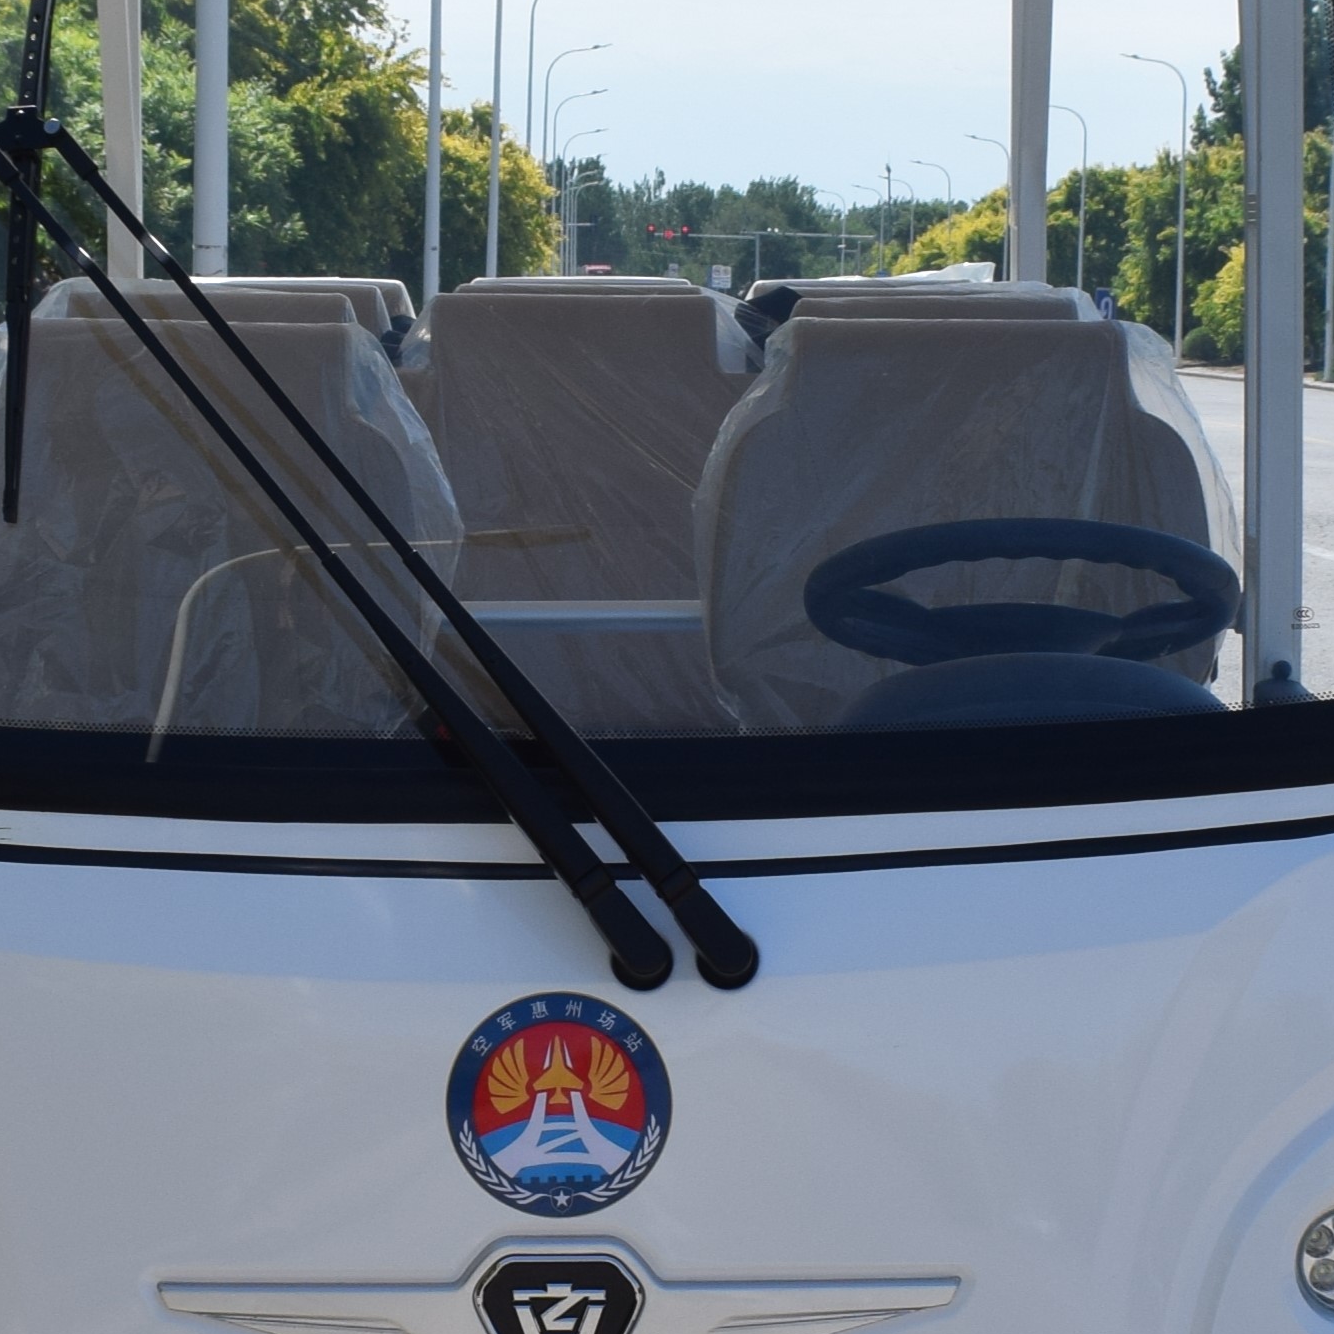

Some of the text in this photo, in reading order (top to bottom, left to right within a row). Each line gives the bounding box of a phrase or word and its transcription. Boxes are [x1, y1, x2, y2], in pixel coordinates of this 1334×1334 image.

[472, 999, 643, 1056] 空军惠州场站
